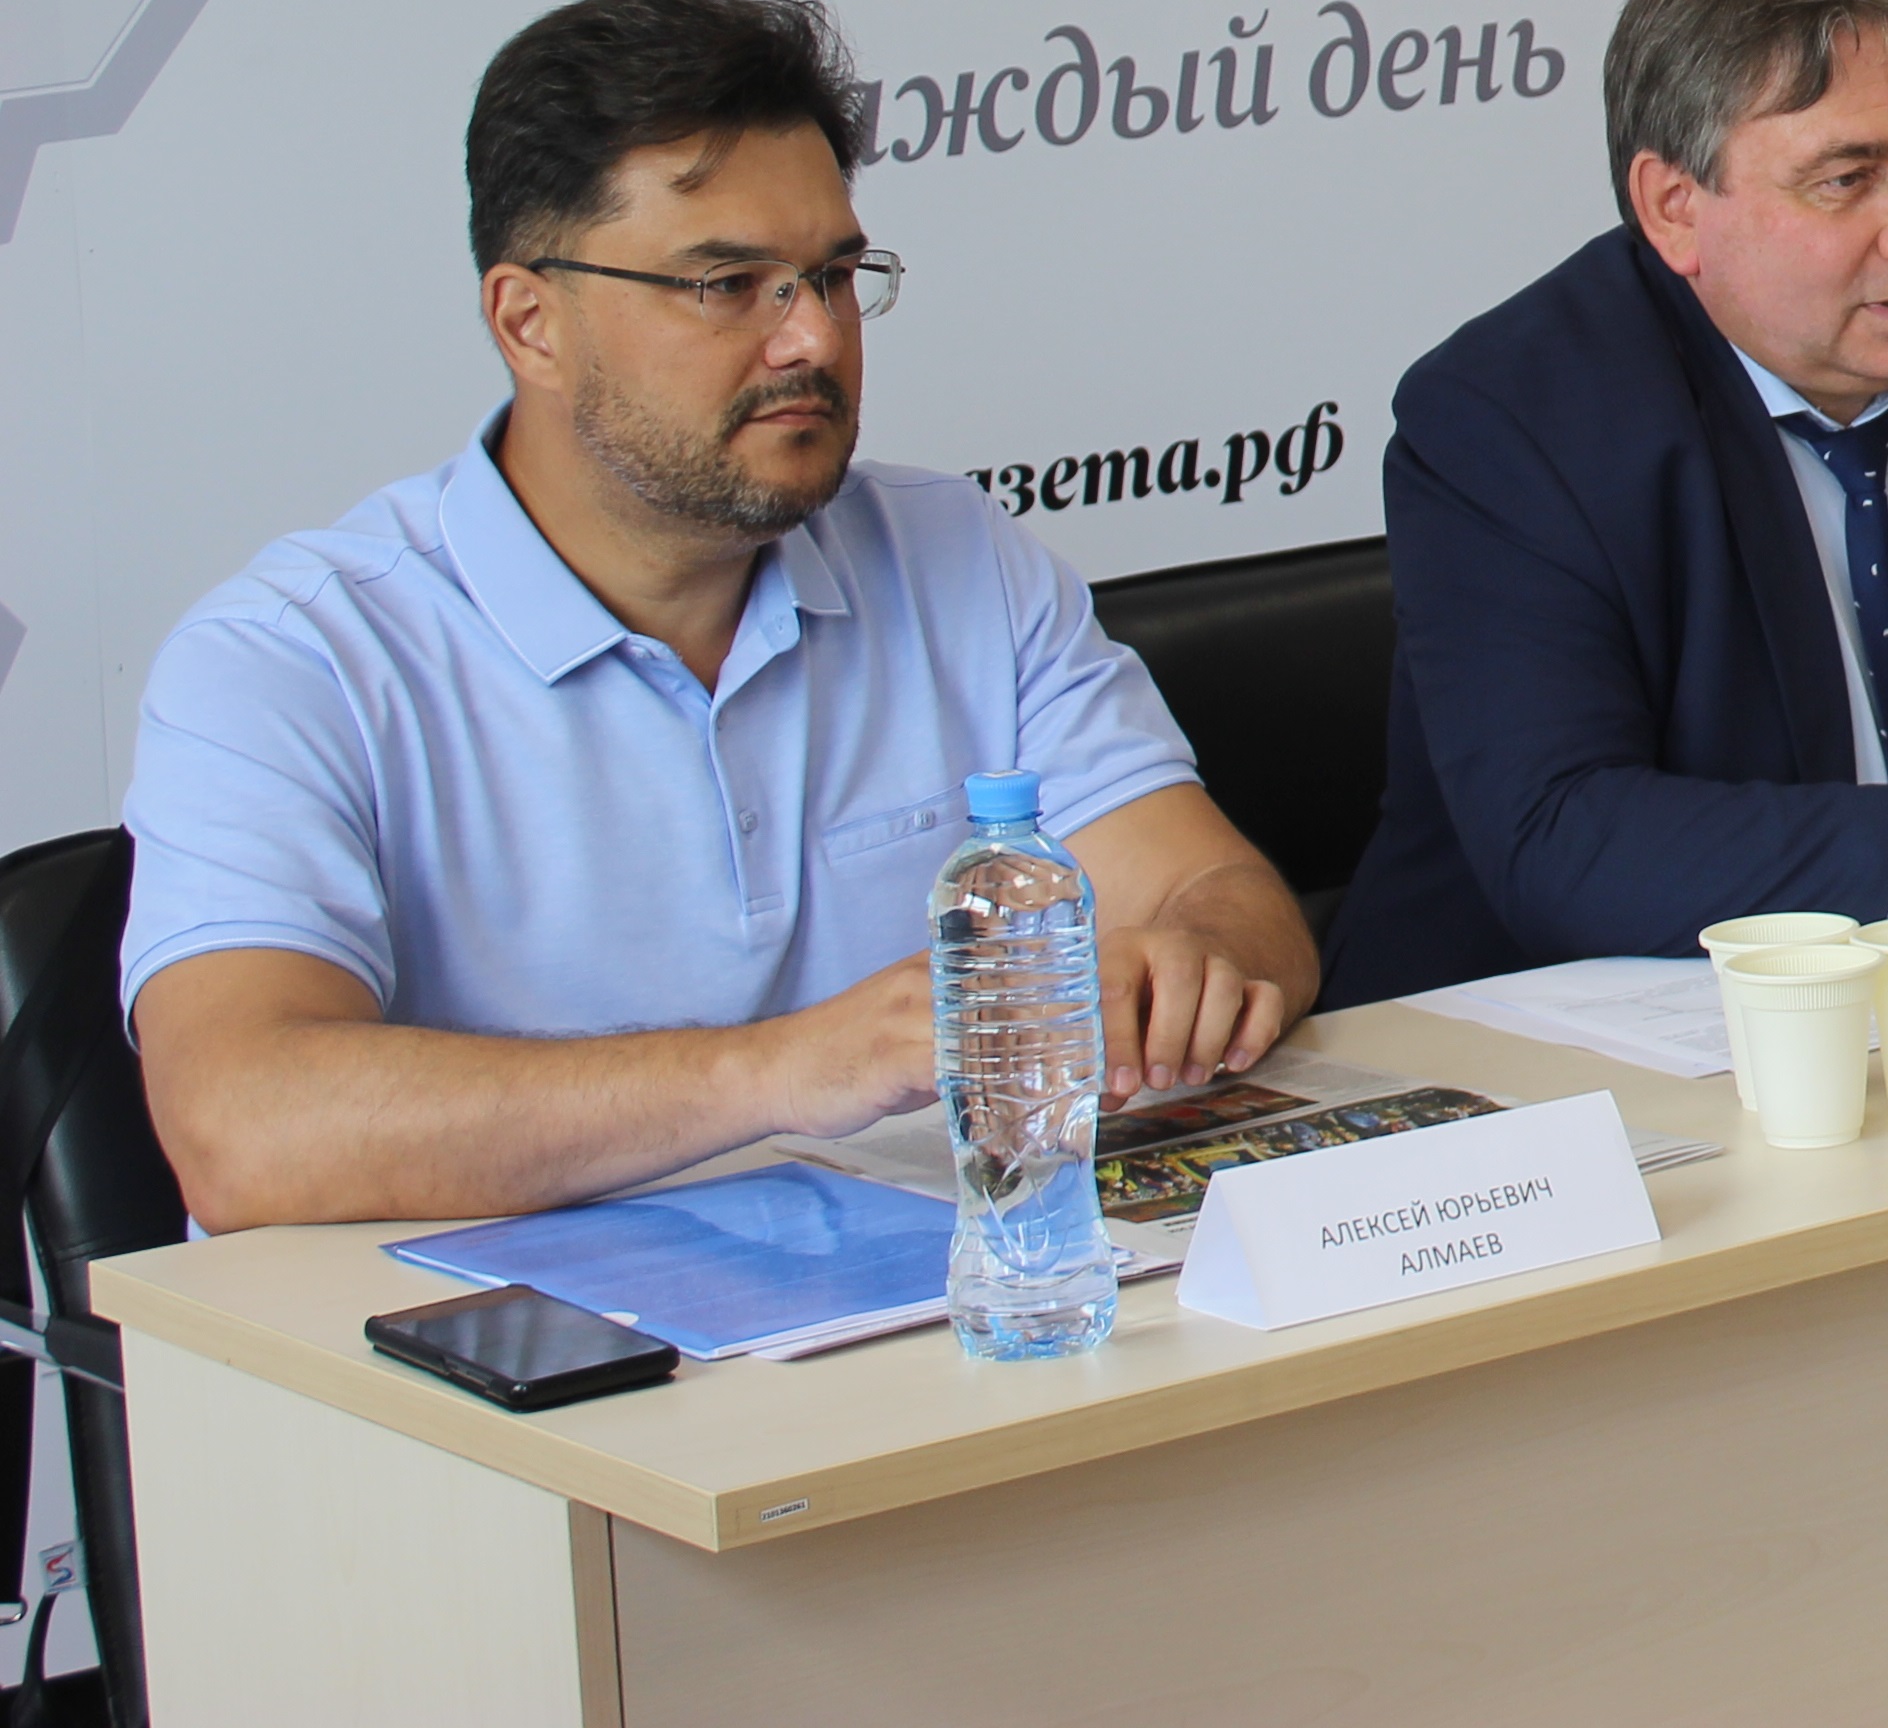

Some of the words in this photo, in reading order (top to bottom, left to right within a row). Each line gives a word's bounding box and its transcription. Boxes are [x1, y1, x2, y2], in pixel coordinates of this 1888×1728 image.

[849, 9, 1279, 166] аждый
[1308, 0, 1566, 118] день
[1322, 1200, 1431, 1249] АЛЕКСЕЙ
[1435, 1177, 1553, 1222] ЮРЬЕВИЧ
[1401, 1233, 1503, 1276] АЛМАЕВ
